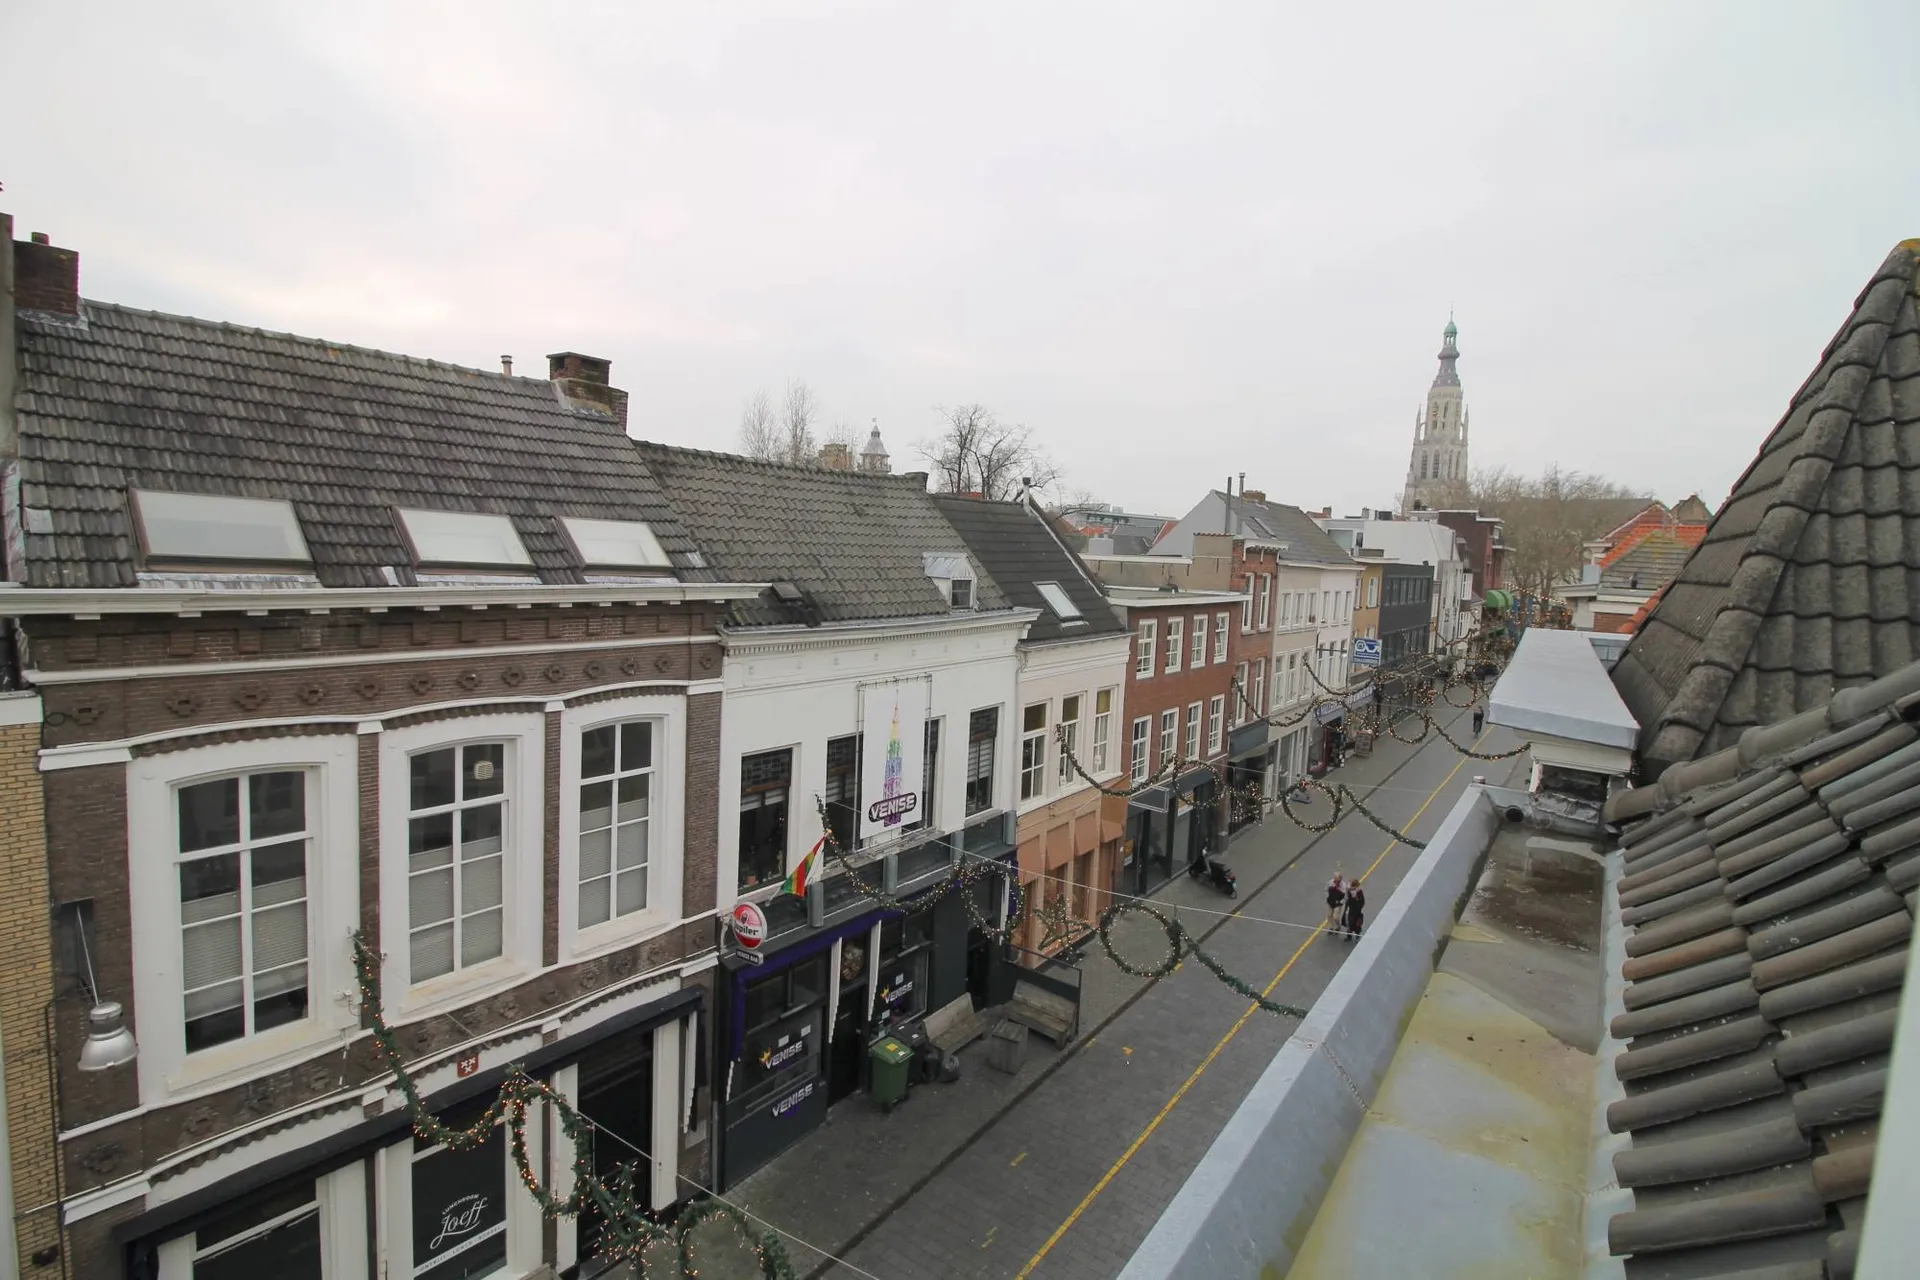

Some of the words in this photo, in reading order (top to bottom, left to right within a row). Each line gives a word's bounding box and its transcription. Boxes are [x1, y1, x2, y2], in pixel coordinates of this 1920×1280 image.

[871, 795, 915, 820] VENISE
[885, 981, 913, 1004] VENISE
[765, 1040, 803, 1070] VENISE
[772, 1082, 813, 1117] VENISE
[442, 1194, 480, 1215] LUNCHROOM
